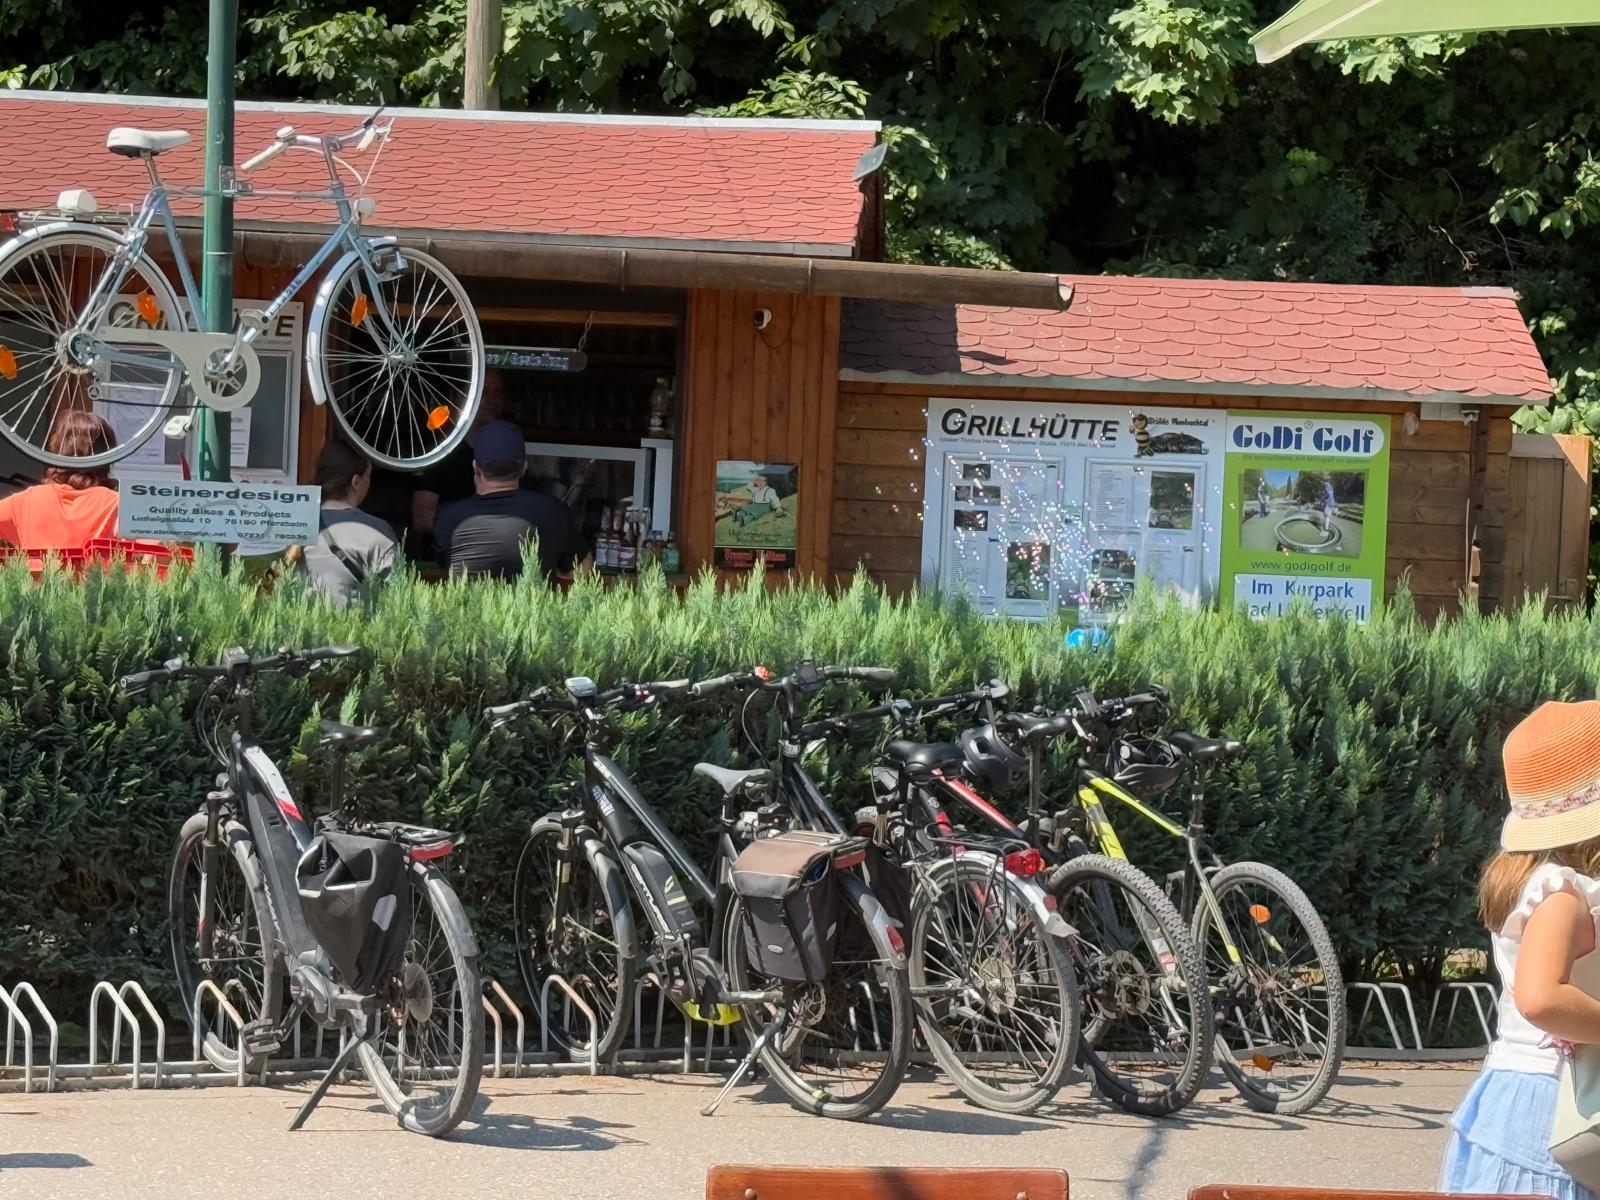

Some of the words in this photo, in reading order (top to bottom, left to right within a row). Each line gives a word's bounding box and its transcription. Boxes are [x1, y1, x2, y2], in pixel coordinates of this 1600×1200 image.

[941, 407, 1120, 441] GRILLHÜTTE
[1233, 424, 1303, 450] GoDi
[1312, 427, 1374, 453] Golf
[130, 484, 310, 503] Steinerdesign
[149, 506, 188, 516] Quality
[191, 508, 224, 516] Bikes
[228, 509, 236, 517] &
[240, 510, 292, 519] Products
[1251, 560, 1352, 573] www.godigolf.de
[1251, 578, 1273, 596] Im
